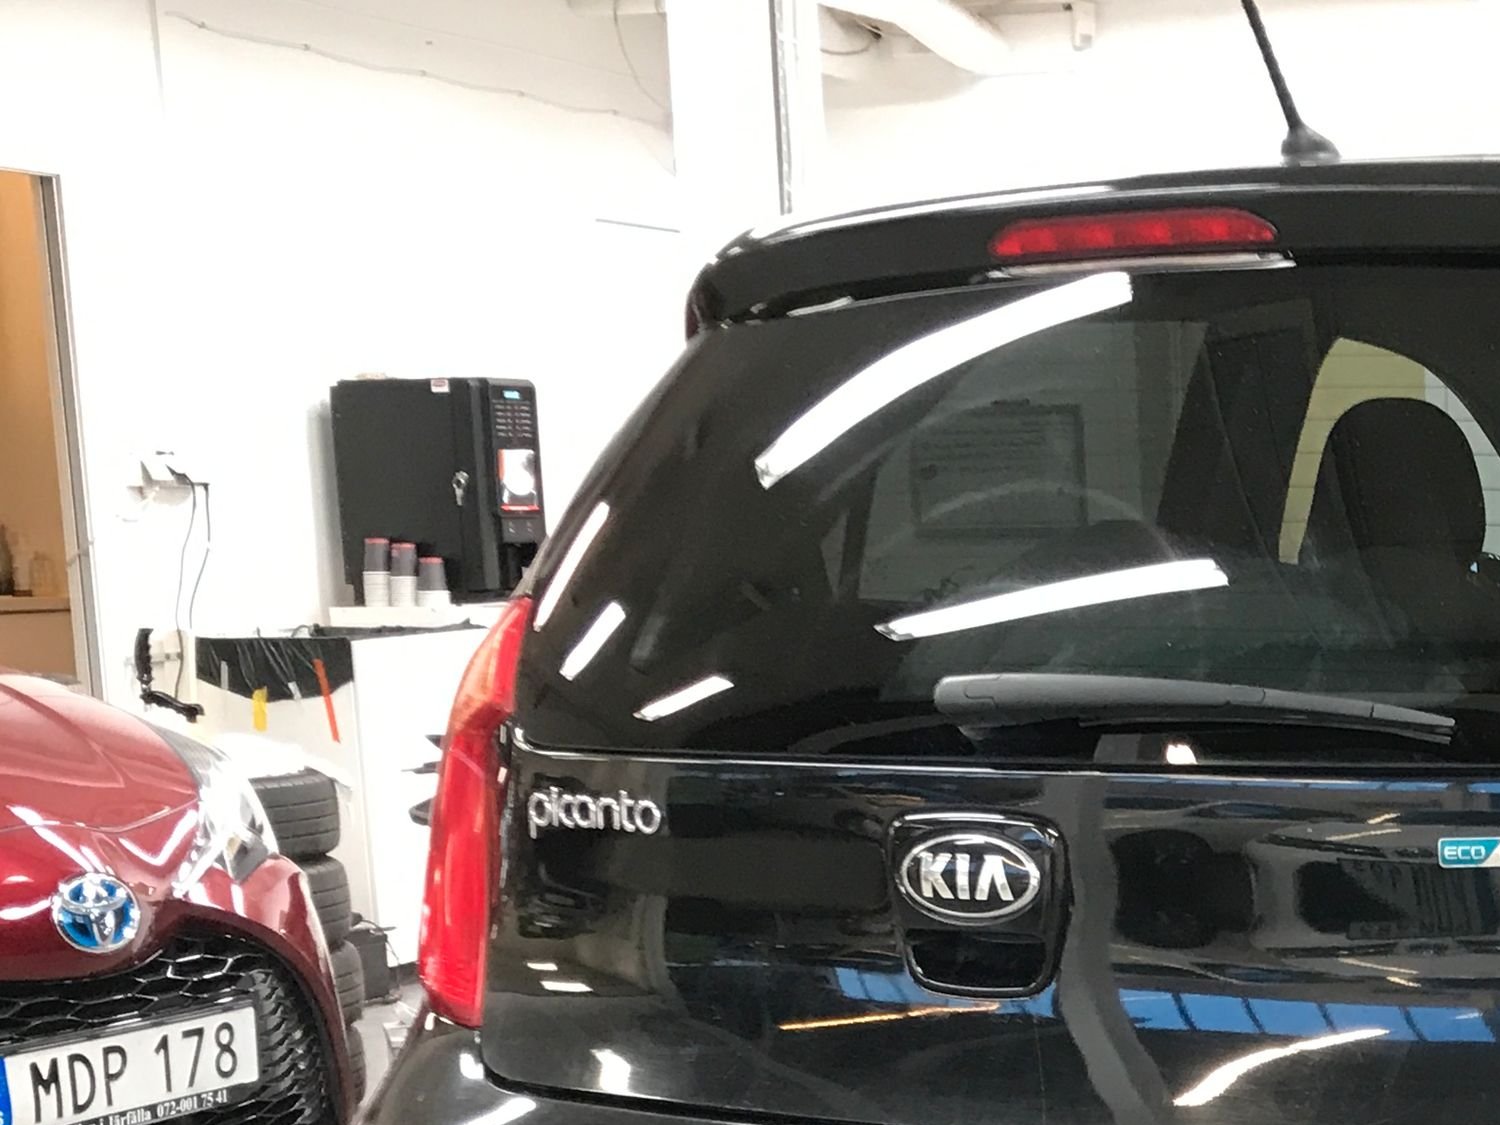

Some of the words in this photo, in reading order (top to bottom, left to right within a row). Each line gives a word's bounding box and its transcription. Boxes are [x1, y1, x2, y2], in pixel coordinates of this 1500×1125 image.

[527, 785, 662, 840] picanto
[918, 851, 1015, 902] KIA
[1443, 844, 1487, 861] ECO
[29, 1044, 127, 1125] MDP
[153, 1021, 238, 1094] 178
[156, 1095, 199, 1118] 072-001
[200, 1093, 214, 1109] 75
[215, 1088, 228, 1104] 41
